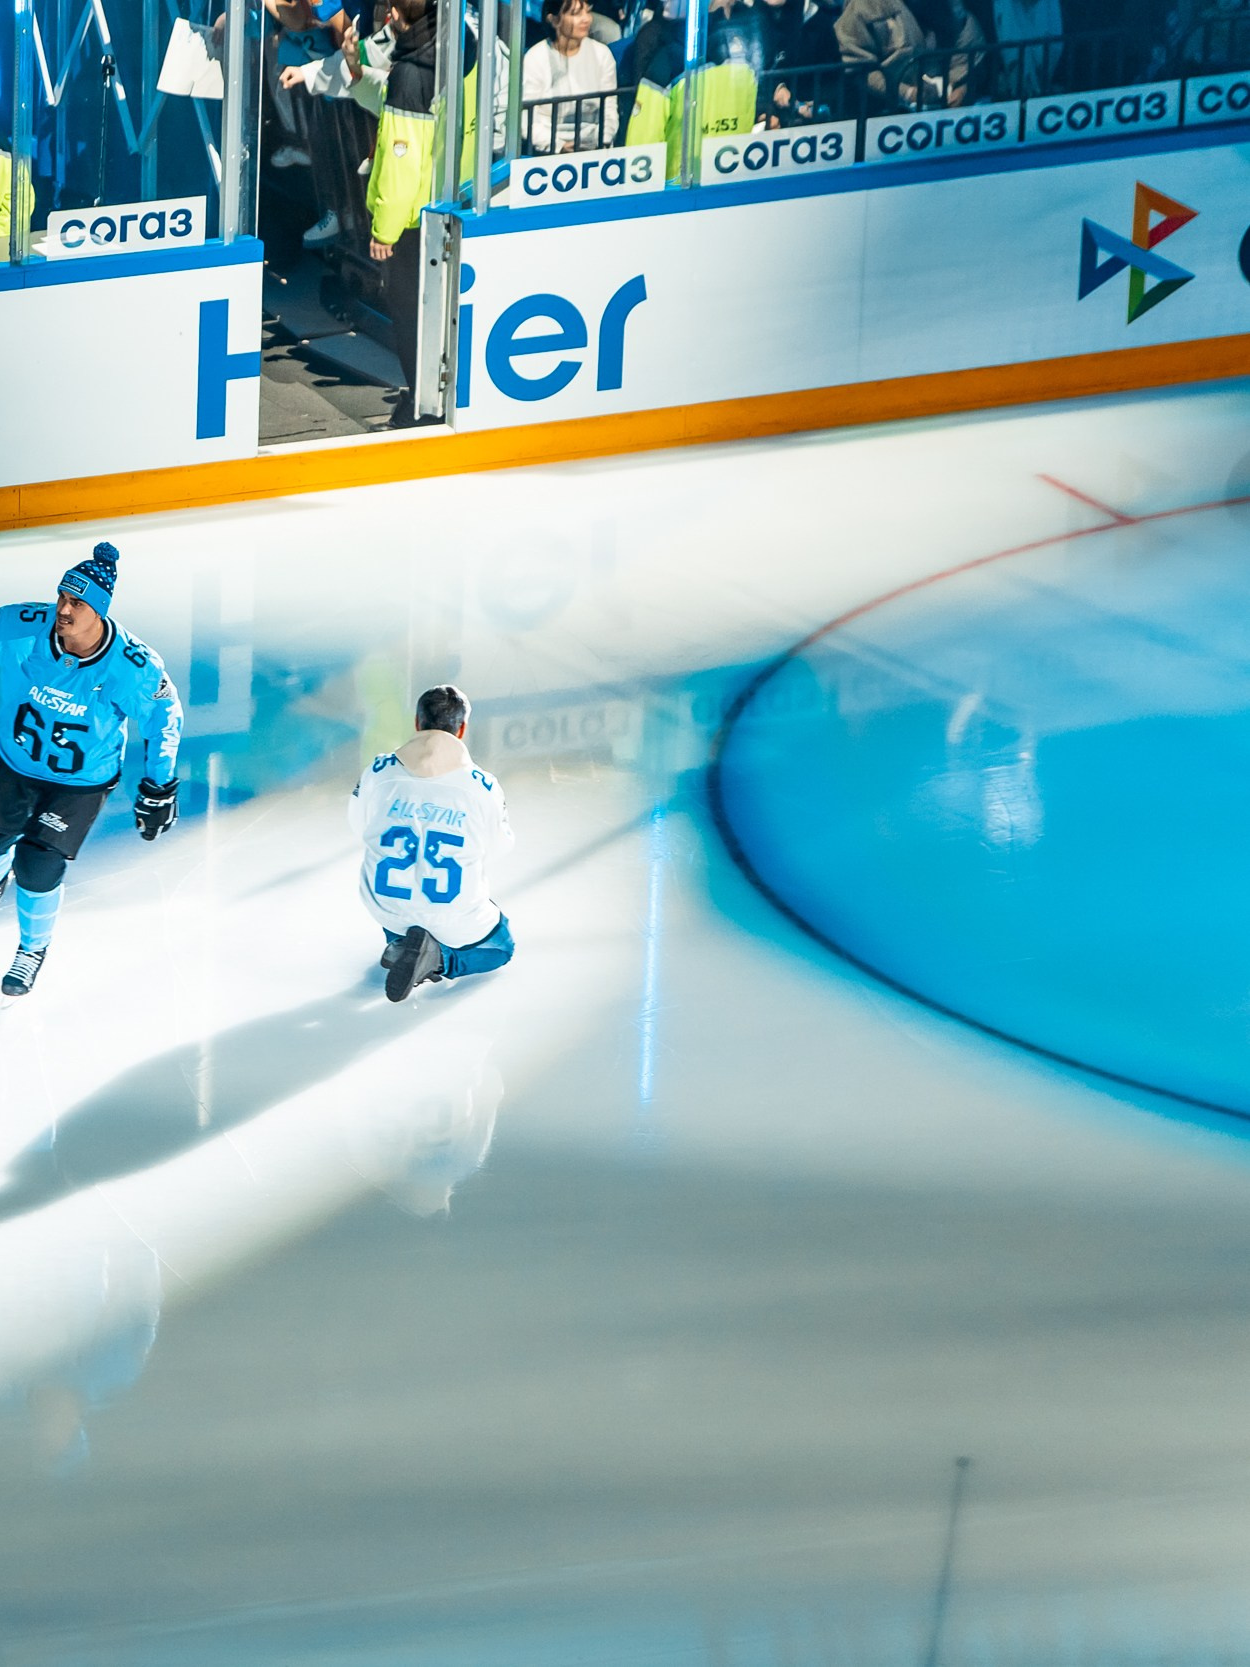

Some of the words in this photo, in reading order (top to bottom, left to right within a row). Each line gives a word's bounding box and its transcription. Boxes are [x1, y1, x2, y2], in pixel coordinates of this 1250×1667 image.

[877, 112, 1007, 154] согаз
[1038, 92, 1167, 134] согаз
[714, 131, 843, 174] согаз
[522, 156, 653, 196] согаз
[59, 208, 193, 249] согаз
[13, 702, 90, 774] 65
[374, 826, 465, 904] 25
